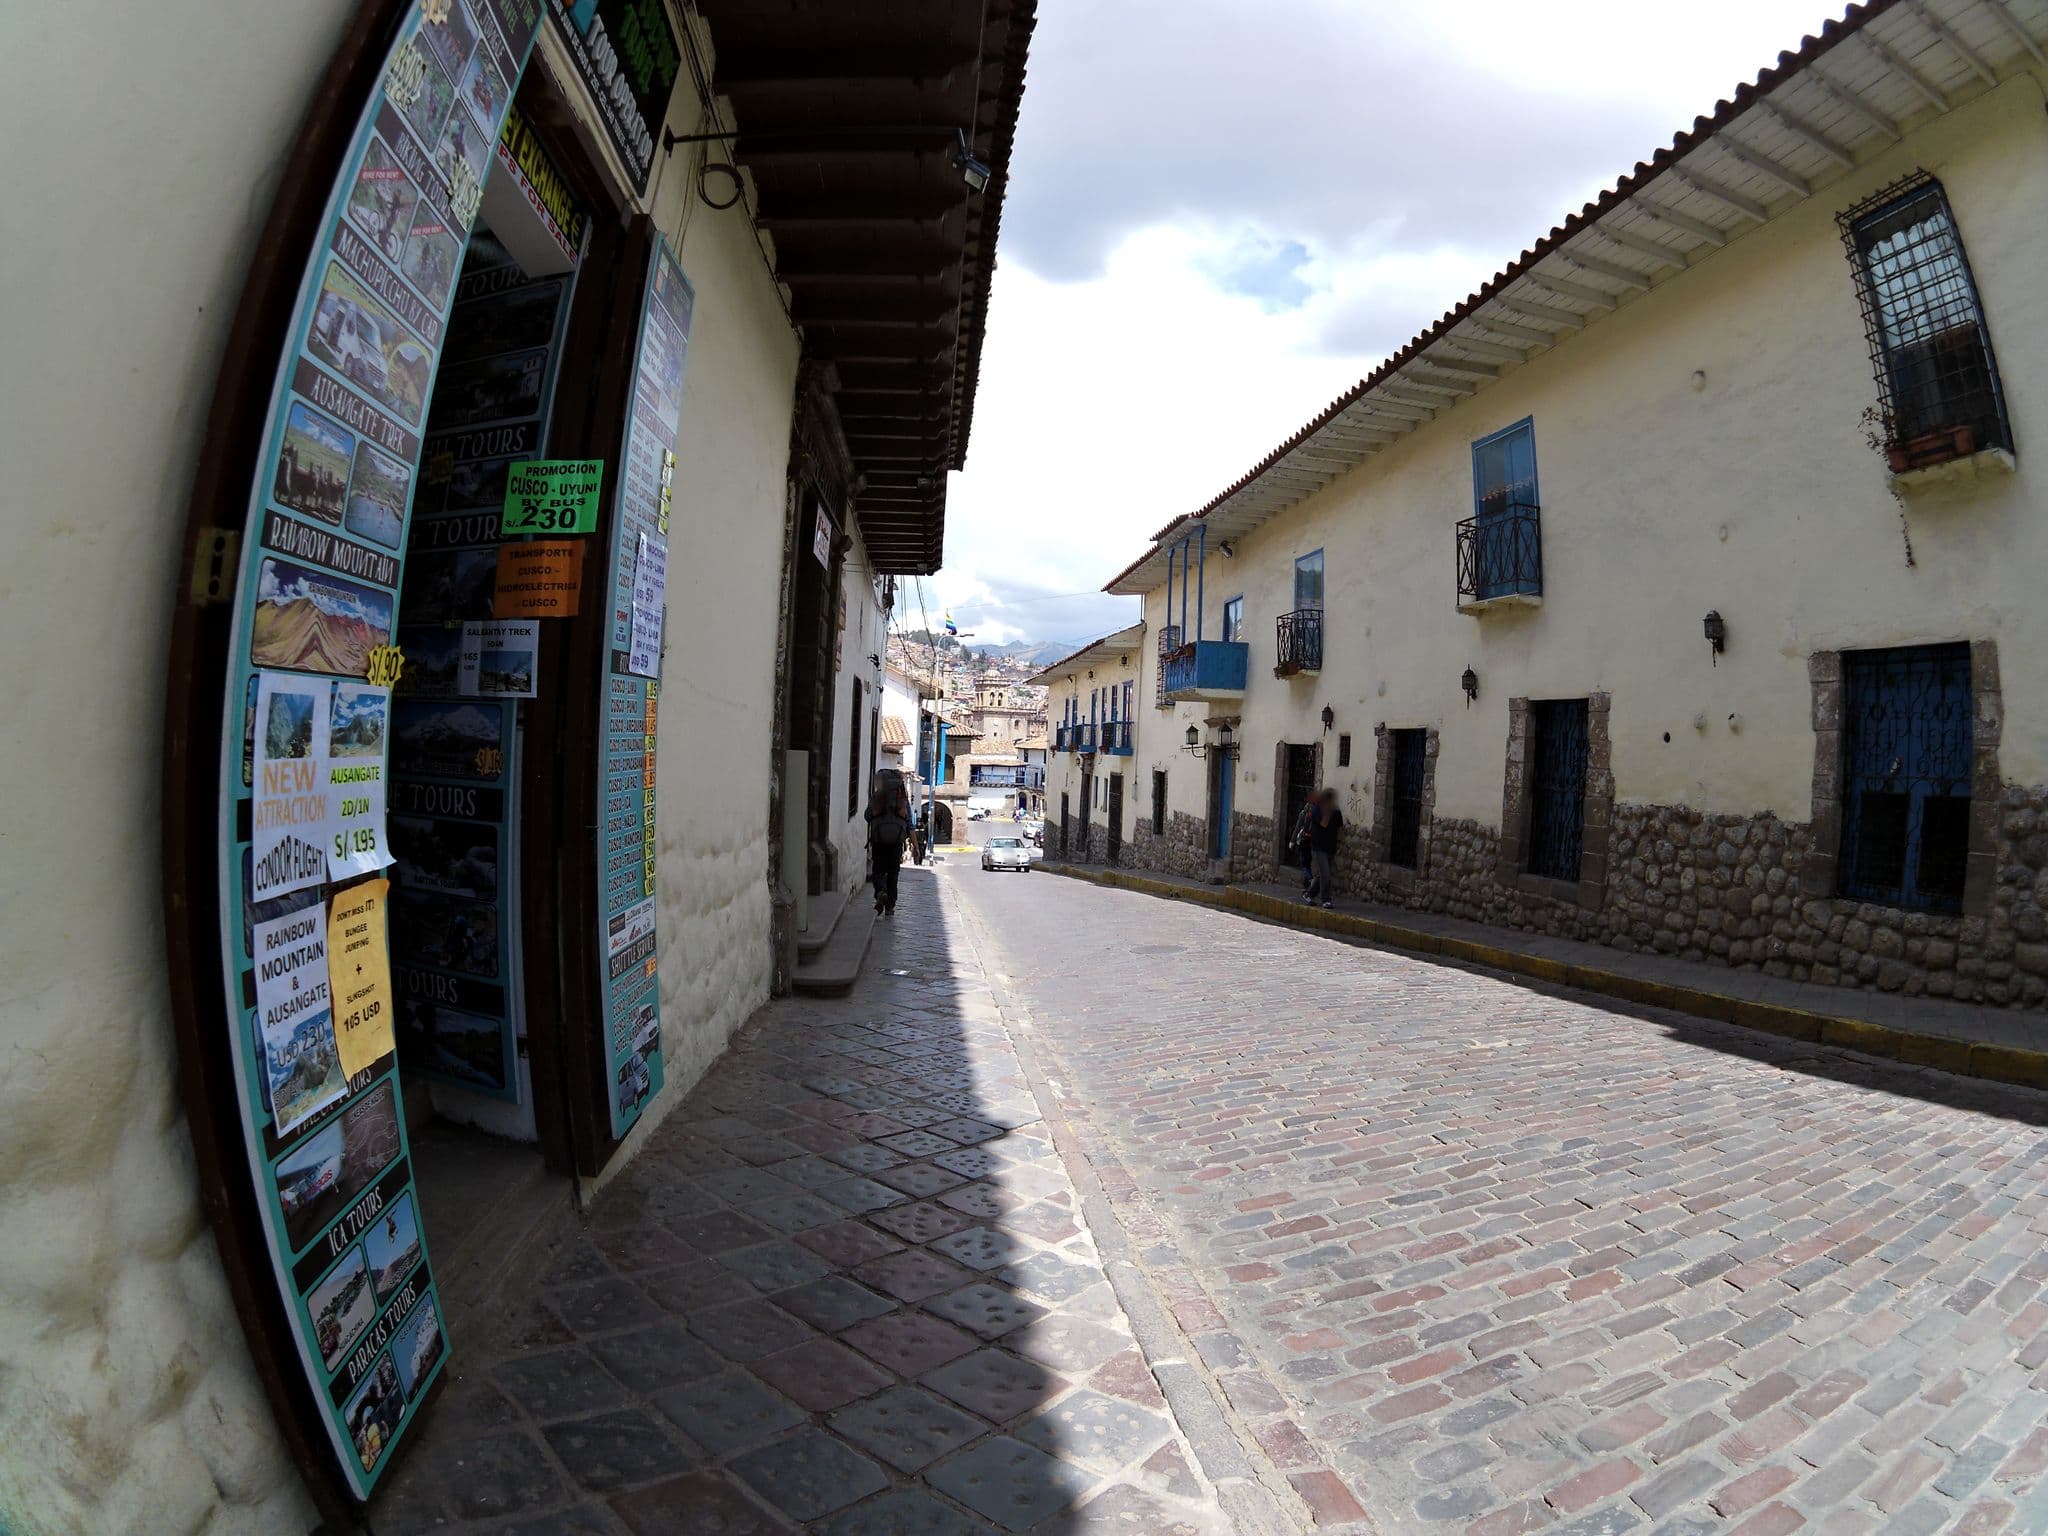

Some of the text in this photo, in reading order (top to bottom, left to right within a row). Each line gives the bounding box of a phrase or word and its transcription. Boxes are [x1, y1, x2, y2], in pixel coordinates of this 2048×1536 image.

[586, 13, 618, 88] TOUR
[609, 72, 655, 169] OPERATOR
[518, 127, 573, 237] EXCHANGE
[519, 175, 546, 219] FOR
[547, 219, 578, 265] SALE
[337, 228, 410, 315] MACHUPICCHU
[457, 267, 530, 301] TOUR
[310, 374, 380, 438] AUSANGATE
[381, 416, 406, 455] TREK
[457, 427, 528, 459] TOURS
[510, 476, 549, 496] CUSCO
[559, 482, 598, 496] UYUNI
[525, 463, 598, 477] PROMOCION
[521, 497, 587, 507] BY BUS
[270, 515, 395, 585] RAINBOW MOUNTAIN
[510, 548, 574, 560] TRANSPORTE
[518, 565, 553, 576] CUSCO
[497, 582, 577, 593] HIDROELECTRICA
[645, 587, 655, 604] 59
[521, 599, 558, 609] CUSCO
[509, 627, 532, 637] TREK
[463, 652, 478, 662] 165
[640, 652, 650, 669] 59
[262, 759, 318, 797] NEW
[330, 765, 382, 785] AUSANGATE
[254, 796, 328, 832] ATTRACTION
[341, 797, 371, 819] 2D/1N
[407, 783, 478, 818] TOURS
[256, 834, 324, 892] CONDOR FLIGHT
[336, 909, 351, 923] DONT
[351, 905, 365, 918] MISS
[344, 922, 369, 938] BUNGEE
[266, 917, 317, 952] RAINBOW
[344, 936, 370, 954] JUMPING
[261, 940, 325, 983] MOUNTAIN
[292, 975, 300, 992] &
[346, 983, 377, 1006] SLINGSHOT
[266, 982, 328, 1029] AUSANGATE
[343, 1001, 381, 1034] 105 USD
[276, 1022, 326, 1069] USD 230
[328, 1185, 384, 1257] ICA TOURS
[348, 1326, 387, 1384] PARACAS
[385, 1280, 416, 1330] TOURS
